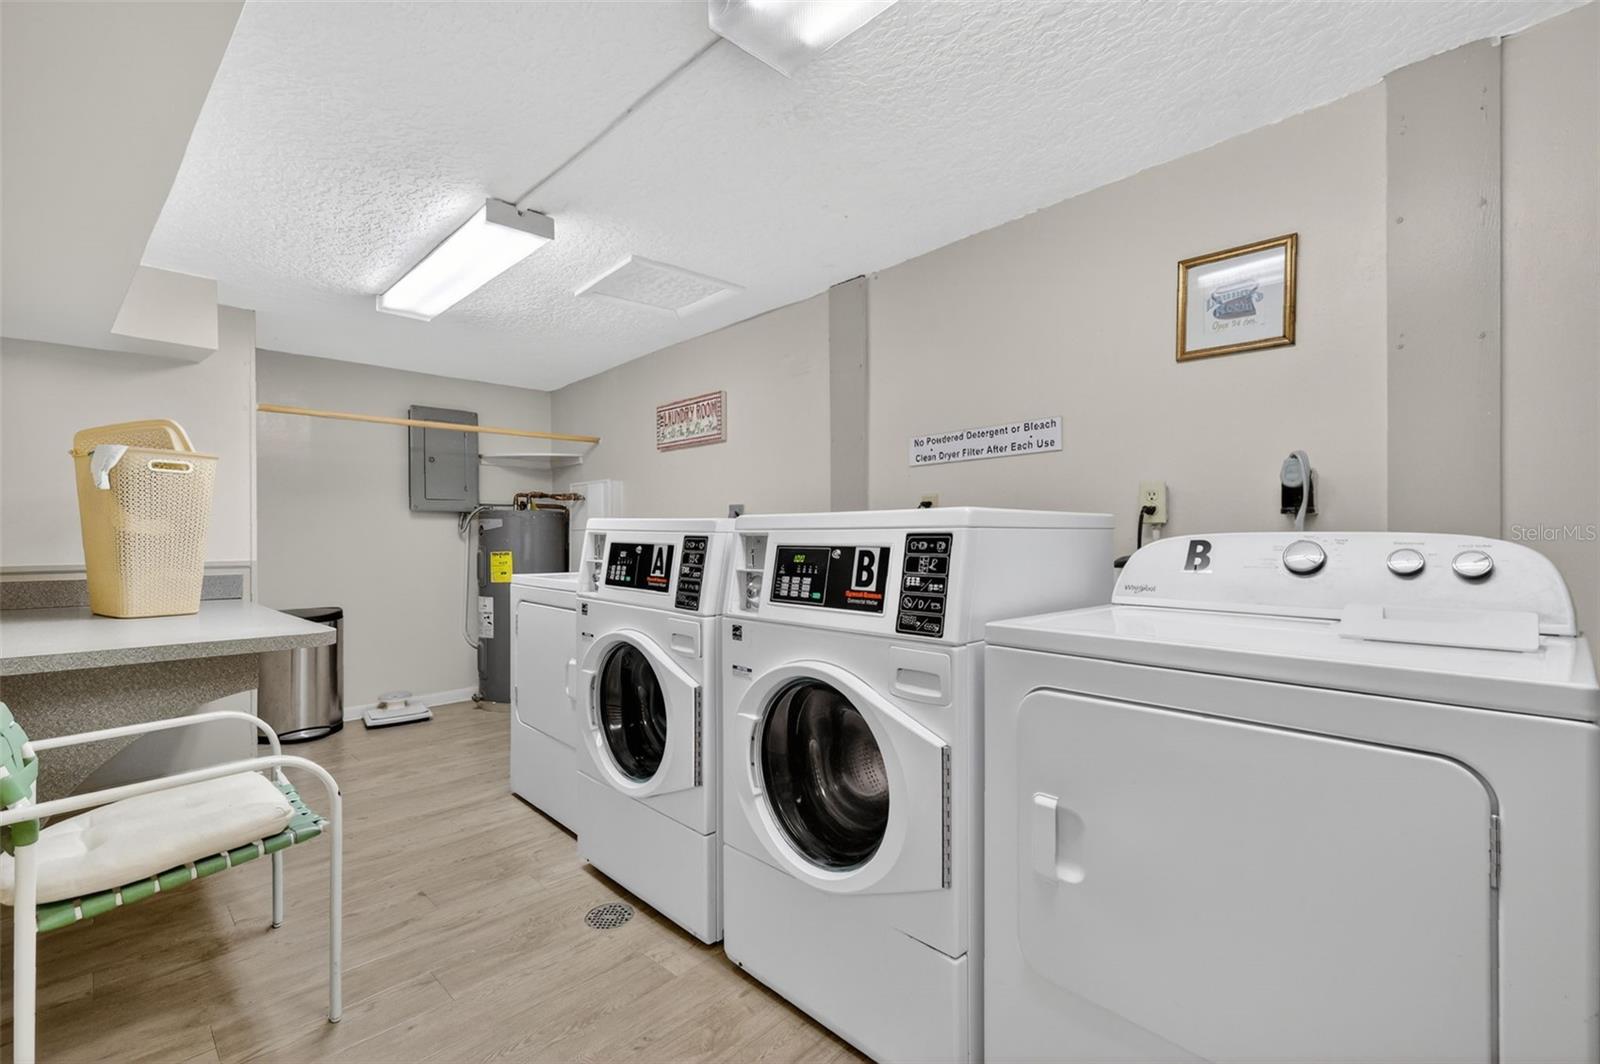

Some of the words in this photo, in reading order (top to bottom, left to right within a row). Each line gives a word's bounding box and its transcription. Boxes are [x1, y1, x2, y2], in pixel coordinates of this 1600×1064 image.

[663, 405, 694, 427] LAUNDRY
[697, 400, 718, 420] ROOM
[914, 439, 925, 448] No
[926, 432, 964, 446] Powdered
[966, 427, 1008, 440] Detergent
[1011, 425, 1020, 433] or
[1023, 419, 1057, 432] Bleach
[915, 453, 937, 463] Clean
[938, 450, 960, 461] Dryer
[962, 447, 984, 457] Filter
[986, 444, 1008, 455] After
[1011, 440, 1033, 452] Each
[1036, 439, 1055, 449] Use
[651, 546, 664, 575] A
[855, 549, 875, 588] B
[1184, 539, 1212, 571] B
